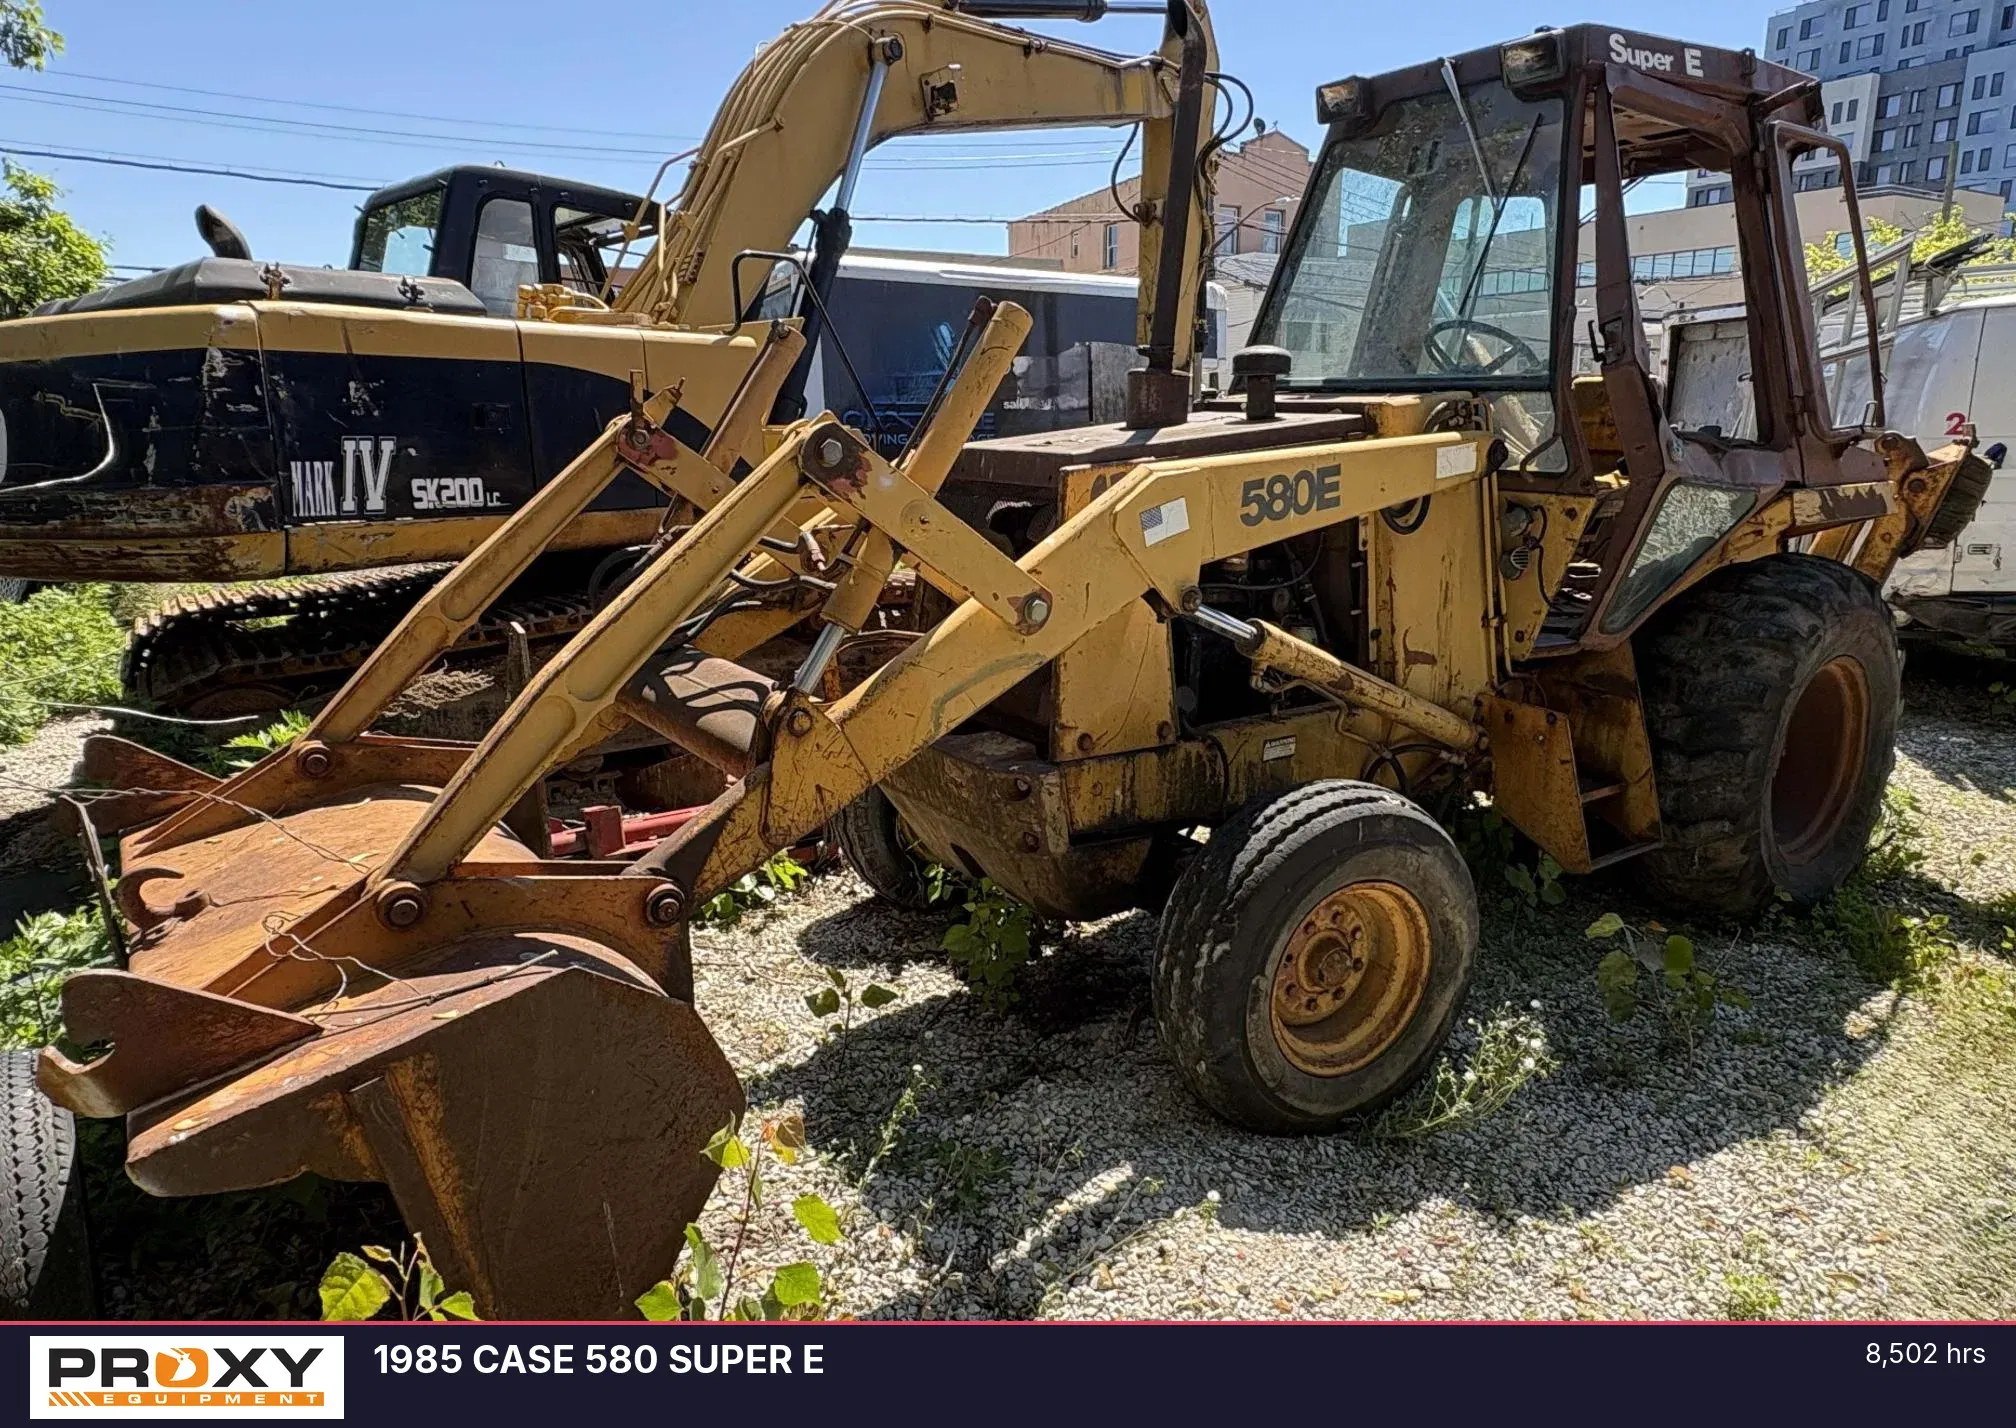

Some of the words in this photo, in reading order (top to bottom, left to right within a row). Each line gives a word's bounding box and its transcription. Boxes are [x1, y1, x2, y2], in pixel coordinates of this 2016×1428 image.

[1609, 33, 1674, 71] Super
[1684, 48, 1704, 78] E
[290, 461, 337, 517] MARK
[340, 435, 397, 515] IV
[411, 477, 484, 510] SK200
[1239, 463, 1342, 528] 580E
